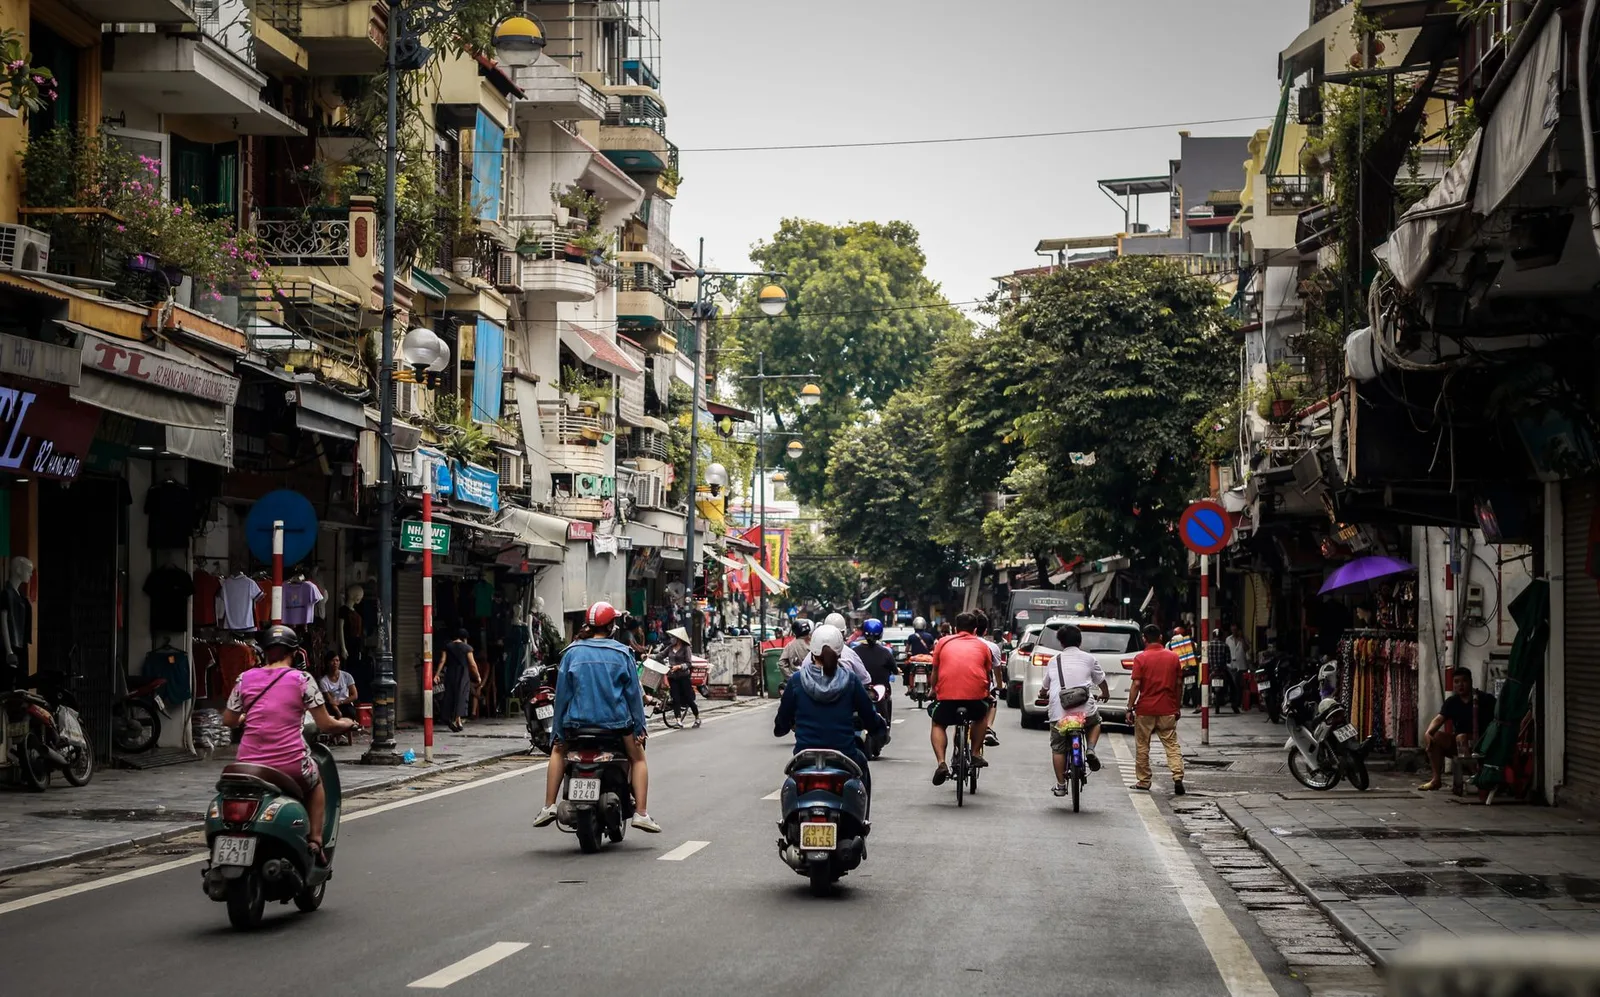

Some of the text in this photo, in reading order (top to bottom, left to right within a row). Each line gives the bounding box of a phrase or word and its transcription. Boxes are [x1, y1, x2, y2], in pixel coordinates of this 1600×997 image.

[13, 339, 35, 373] Huy
[95, 343, 151, 380] TL
[33, 440, 54, 473] 82
[407, 525, 446, 538] NH WC
[573, 790, 595, 799] 8240
[805, 836, 831, 847] 8055
[218, 851, 247, 863] 6431
